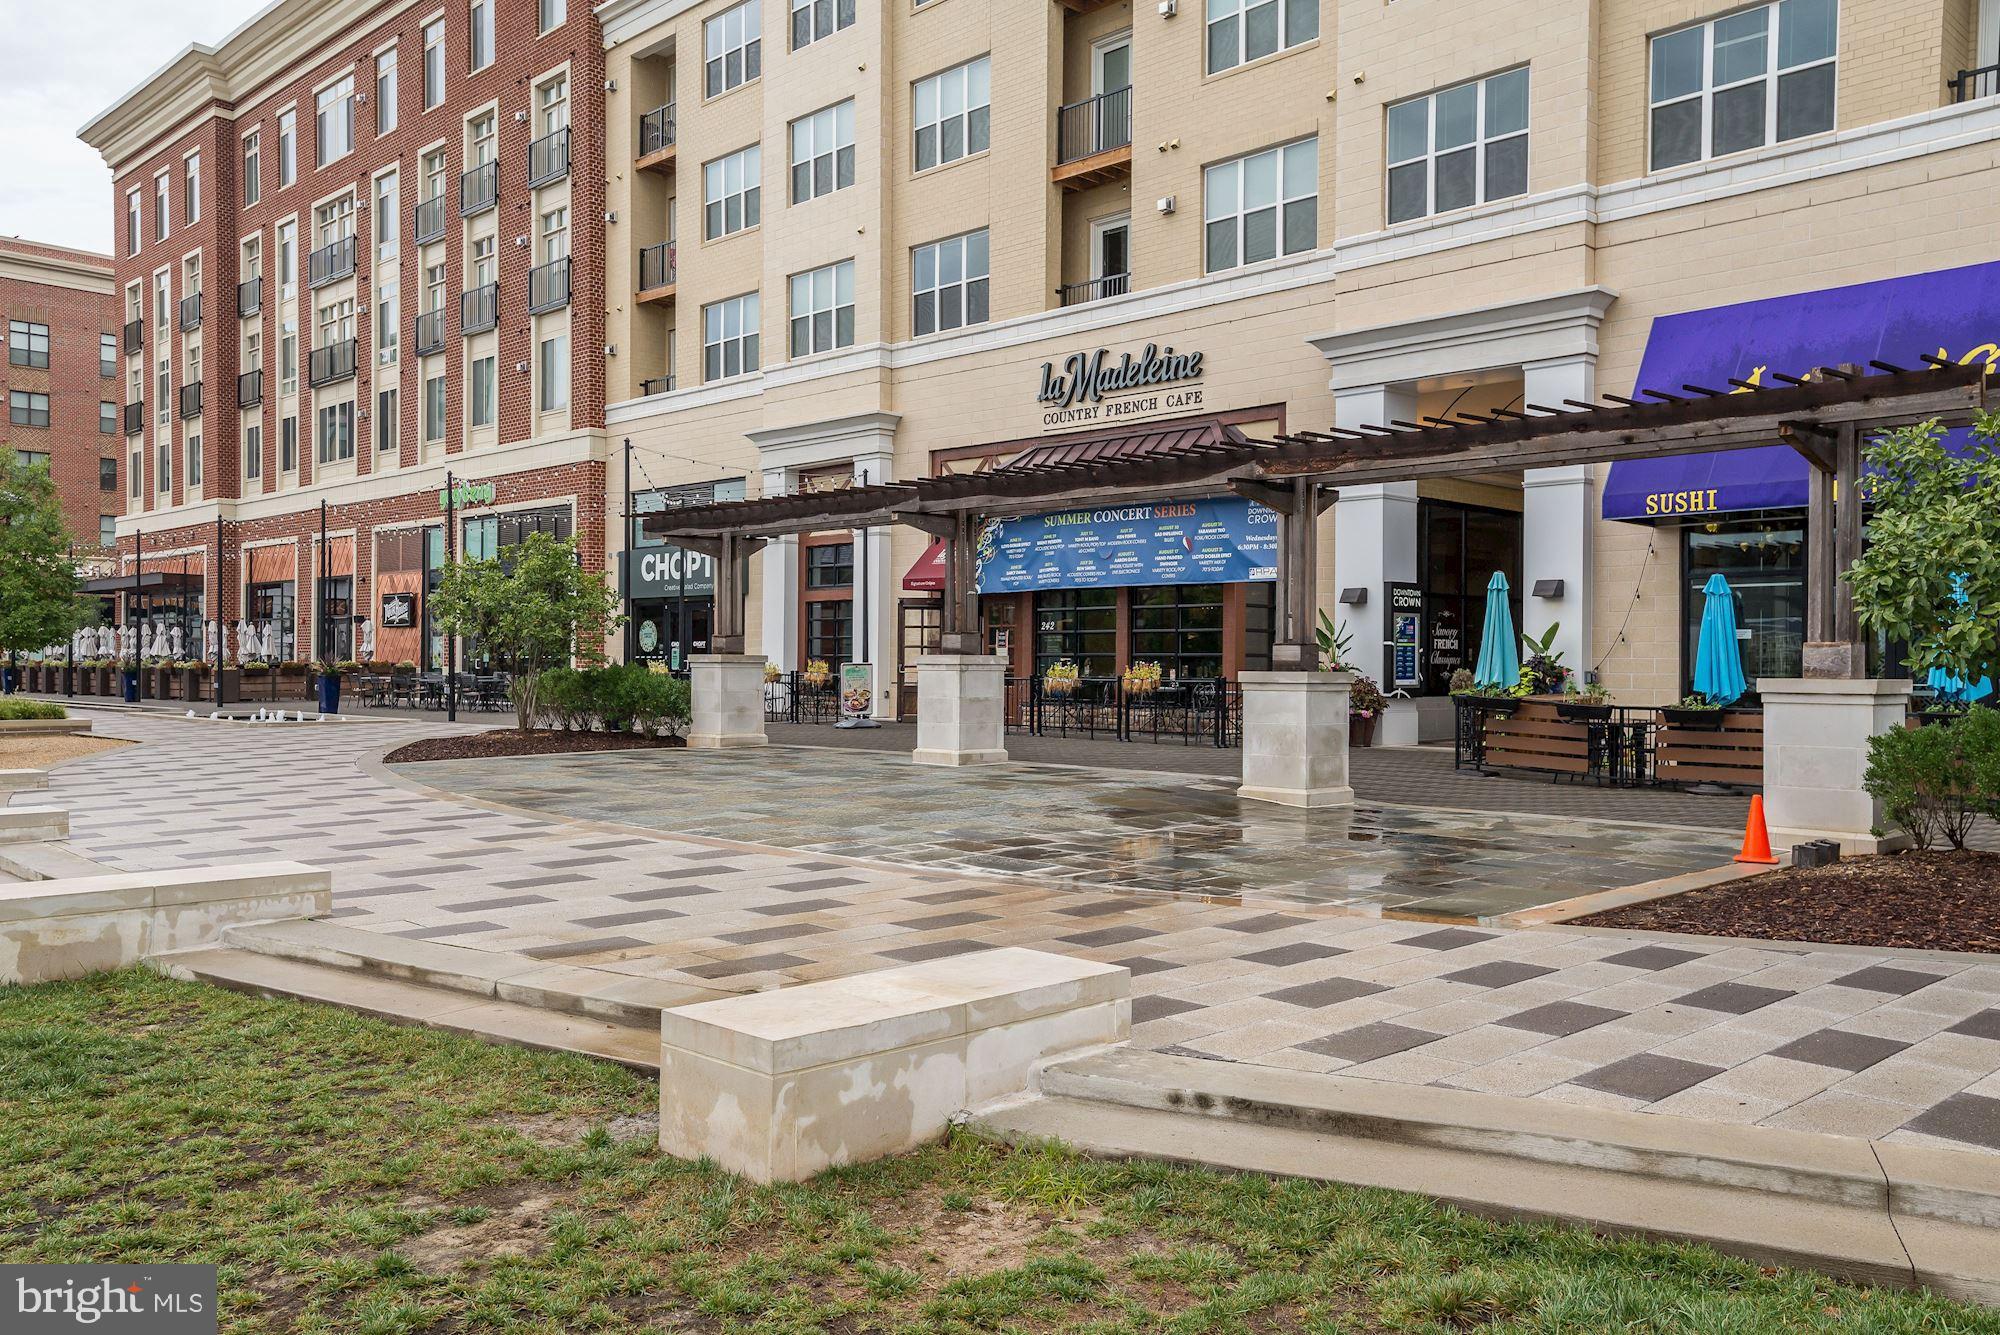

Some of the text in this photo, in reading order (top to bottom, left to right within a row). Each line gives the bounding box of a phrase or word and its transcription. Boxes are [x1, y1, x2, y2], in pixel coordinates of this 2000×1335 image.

[1037, 342, 1204, 408] la Madeleine
[1043, 390, 1203, 425] COUNTRY FRENCH CAFE
[1646, 489, 1718, 515] SUSHI
[1044, 503, 1196, 528] SUMMER CONCERT SERIES
[640, 550, 711, 582] CHOPT
[1393, 588, 1421, 597] DOWNTOWN
[1393, 596, 1421, 608] CROWN
[1041, 621, 1055, 631] 242
[1433, 638, 1459, 650] FRENCH
